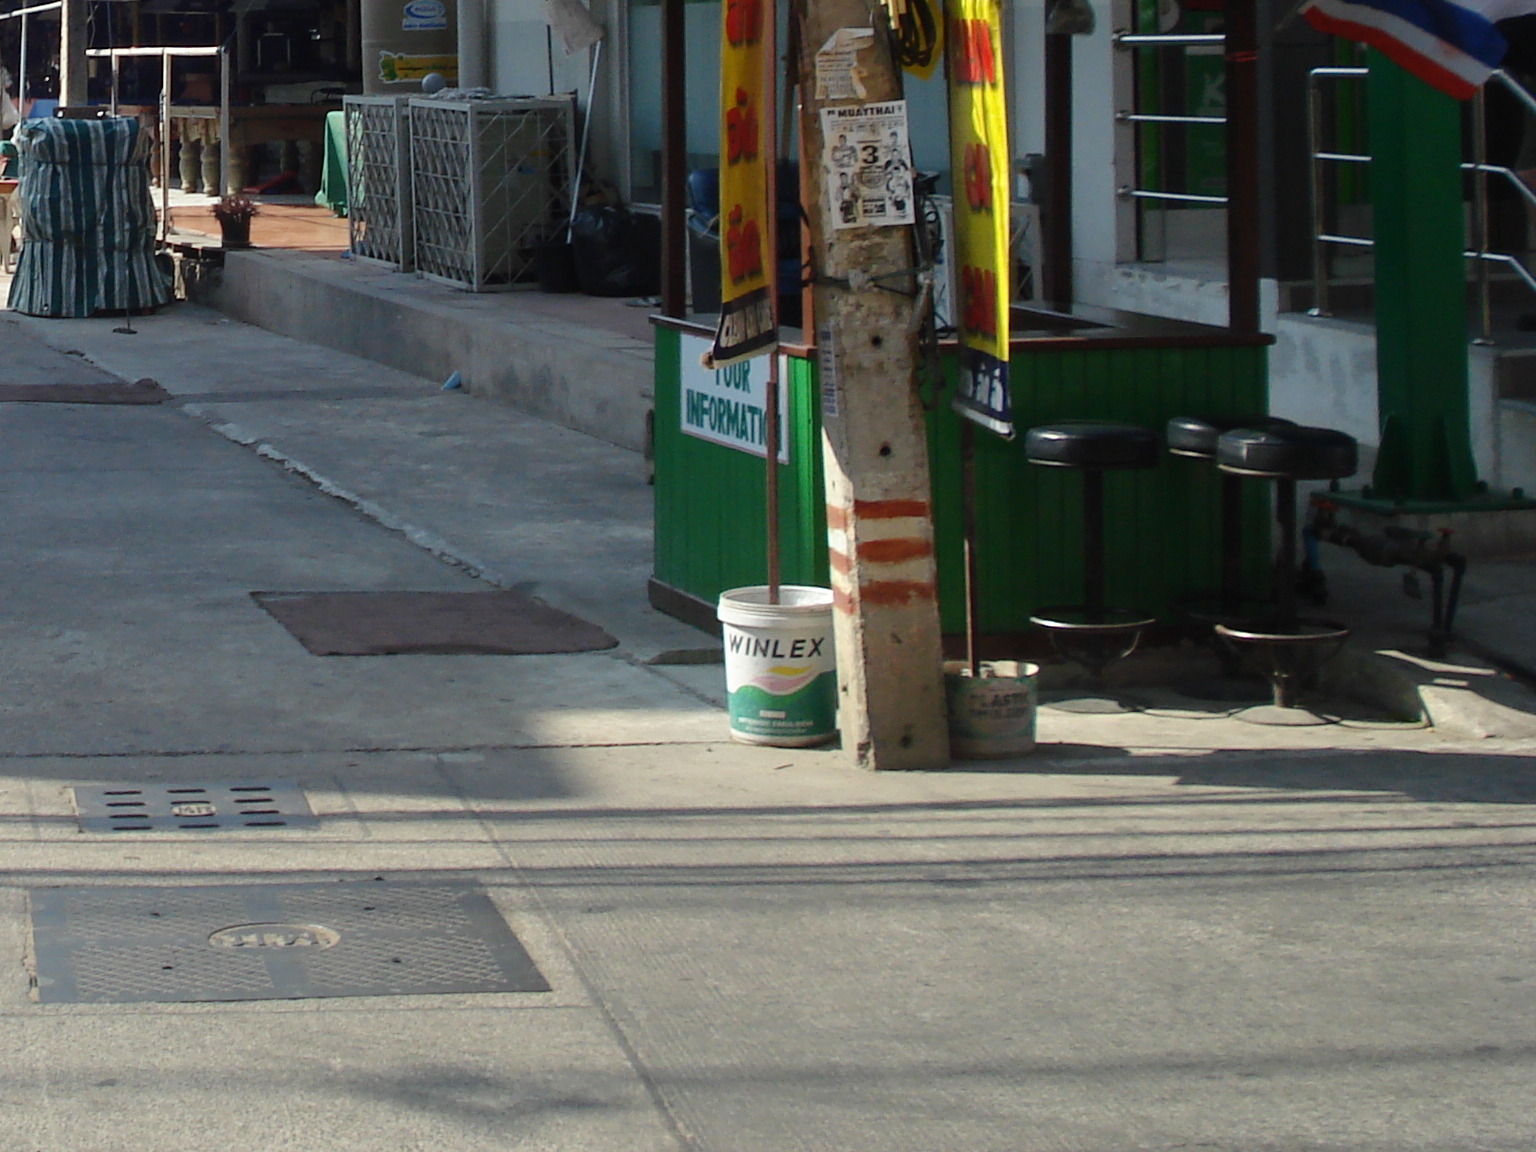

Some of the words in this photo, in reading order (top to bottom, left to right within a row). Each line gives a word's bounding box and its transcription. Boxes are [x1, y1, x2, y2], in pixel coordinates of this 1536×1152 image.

[838, 106, 895, 118] MUAYTHAI
[862, 145, 879, 164] 3
[729, 633, 826, 659] WINLEX
